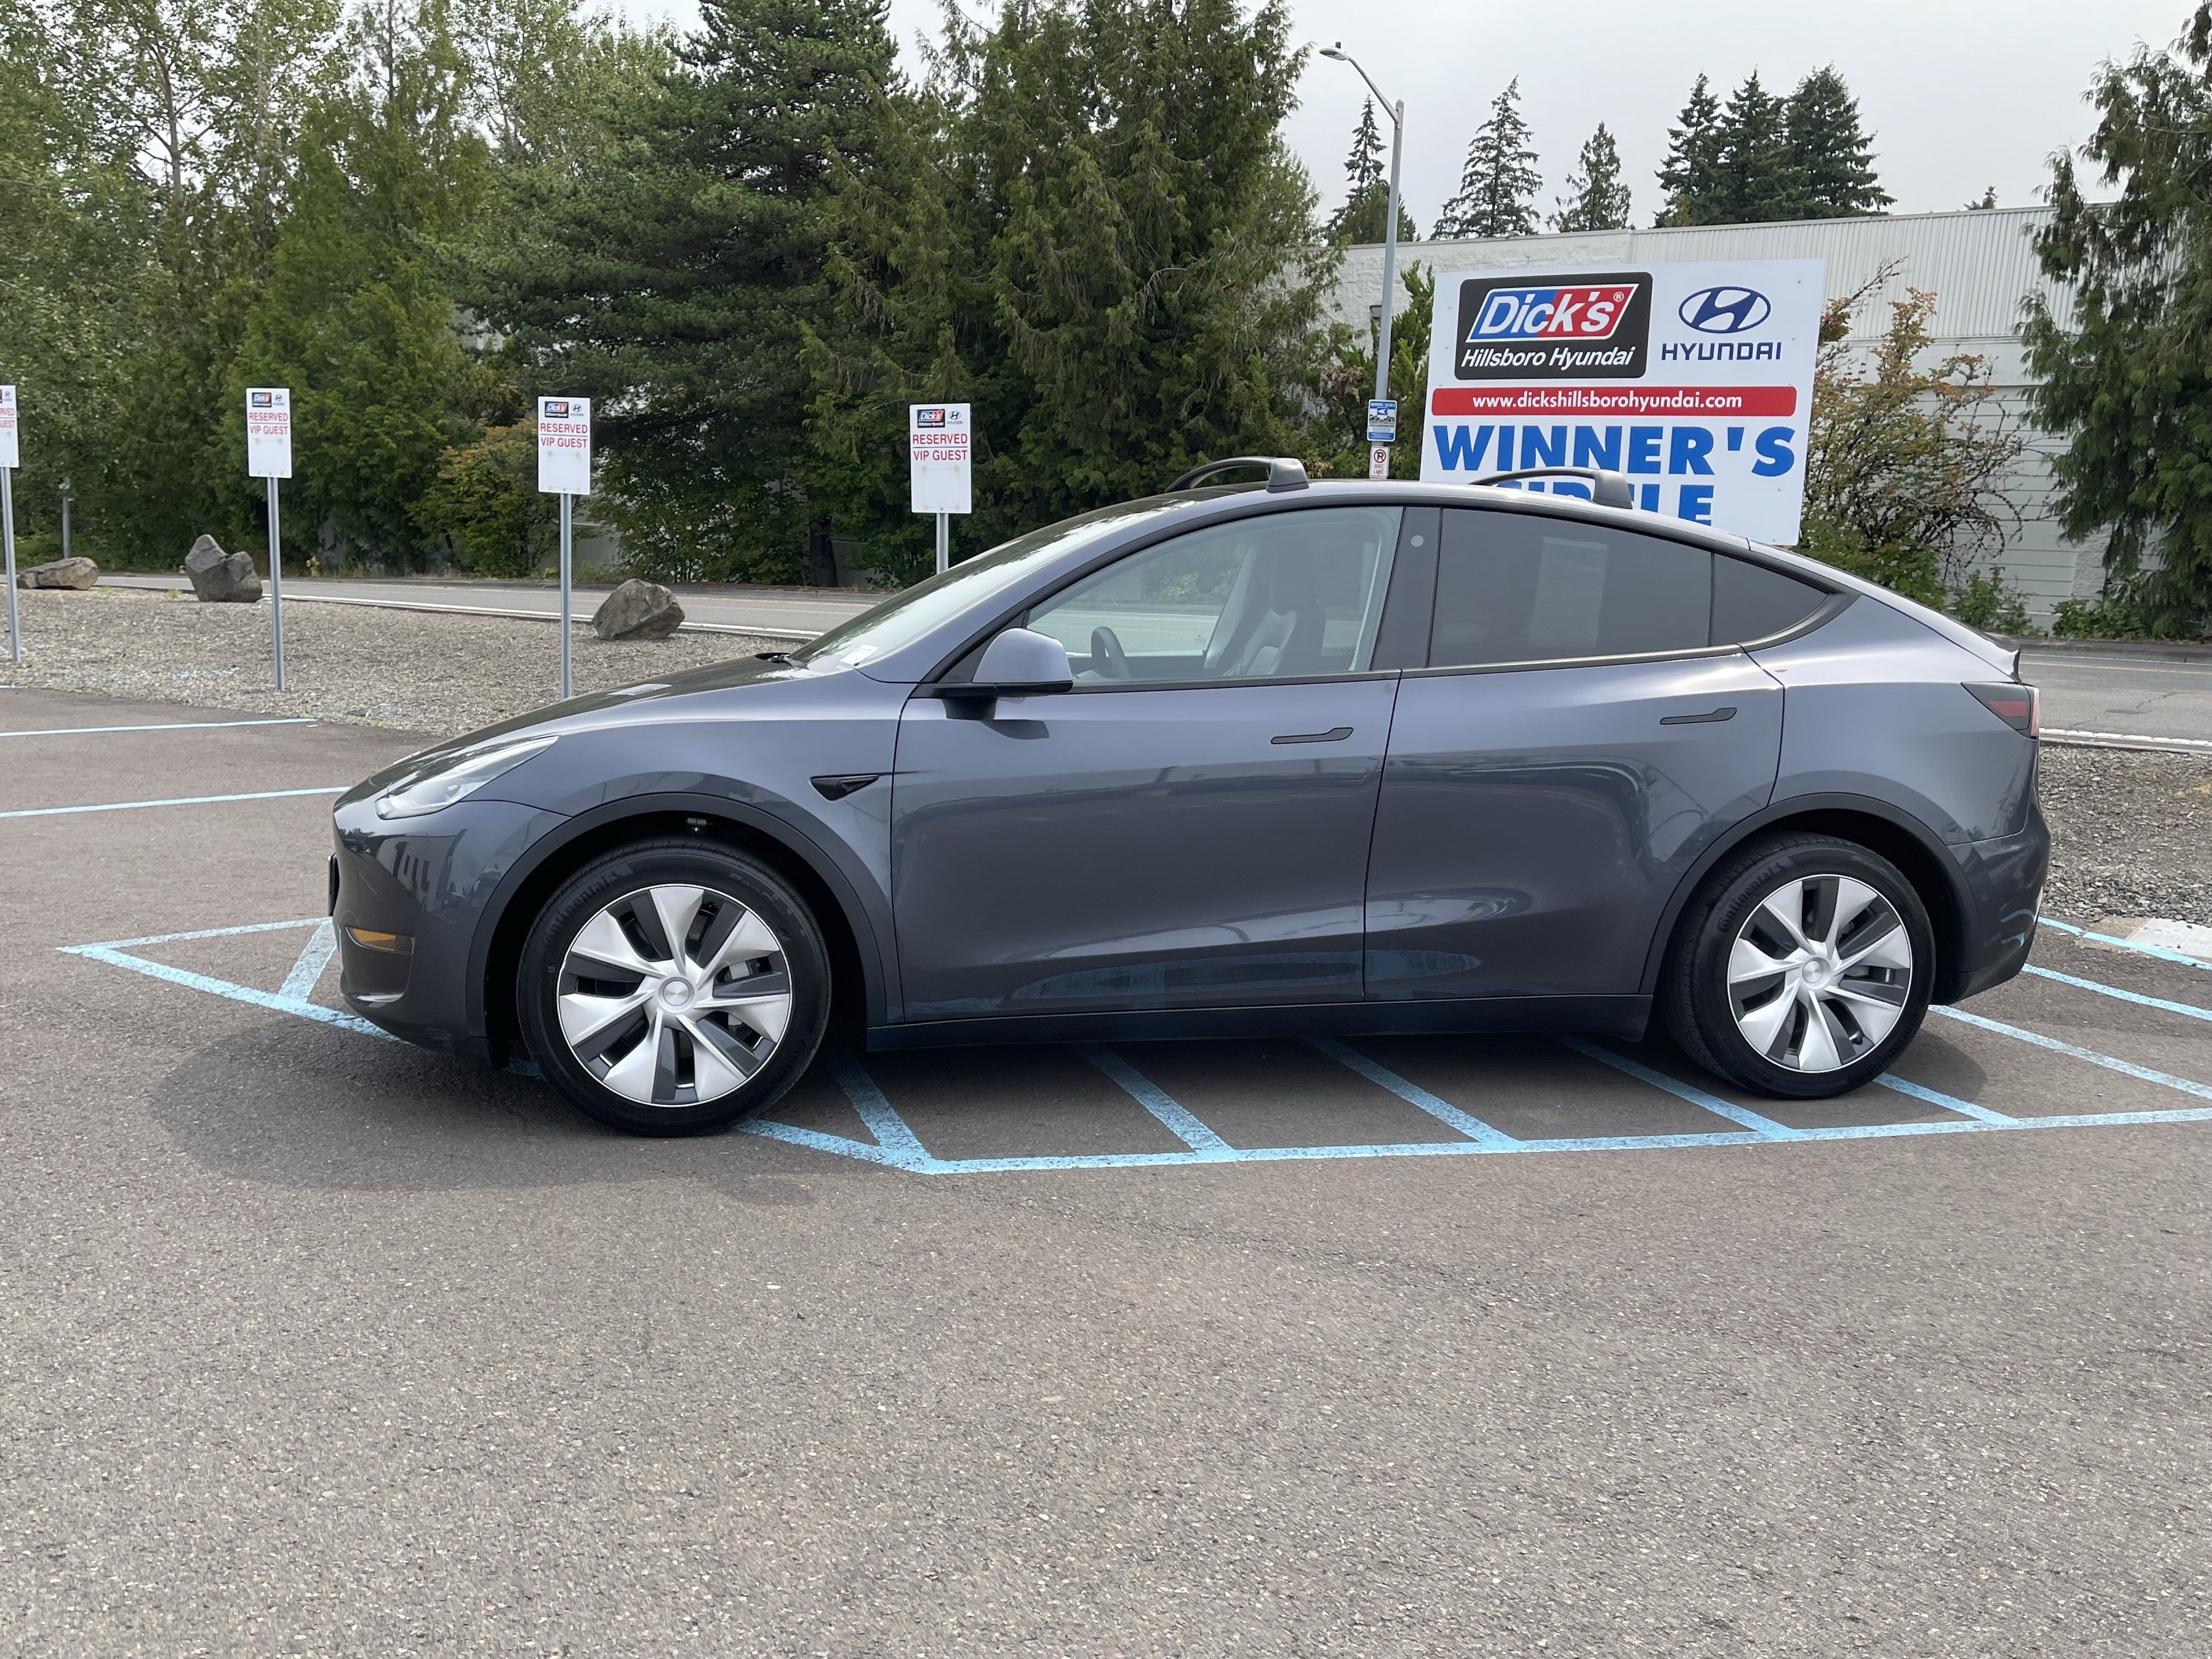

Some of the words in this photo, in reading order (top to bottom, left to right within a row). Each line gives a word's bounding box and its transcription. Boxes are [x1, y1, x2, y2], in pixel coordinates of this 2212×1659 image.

[1481, 291, 1615, 334] Dick's
[1661, 342, 1781, 360] HYUNDAI
[1460, 348, 1546, 368] Hillsboro
[1549, 346, 1635, 370] Hyundai
[1472, 391, 1742, 412] www.dickshillsborohyundai.com
[249, 412, 288, 421] RESERVED
[250, 426, 261, 434] VIP
[263, 426, 288, 435] GUEST
[540, 423, 588, 434] RESERVED
[541, 437, 555, 446] VIP
[557, 438, 588, 448] GUEST
[912, 433, 968, 444] RESERVED
[913, 450, 929, 460] VIP
[933, 450, 968, 460] GUEST
[1432, 425, 1796, 477] WINNER'S
